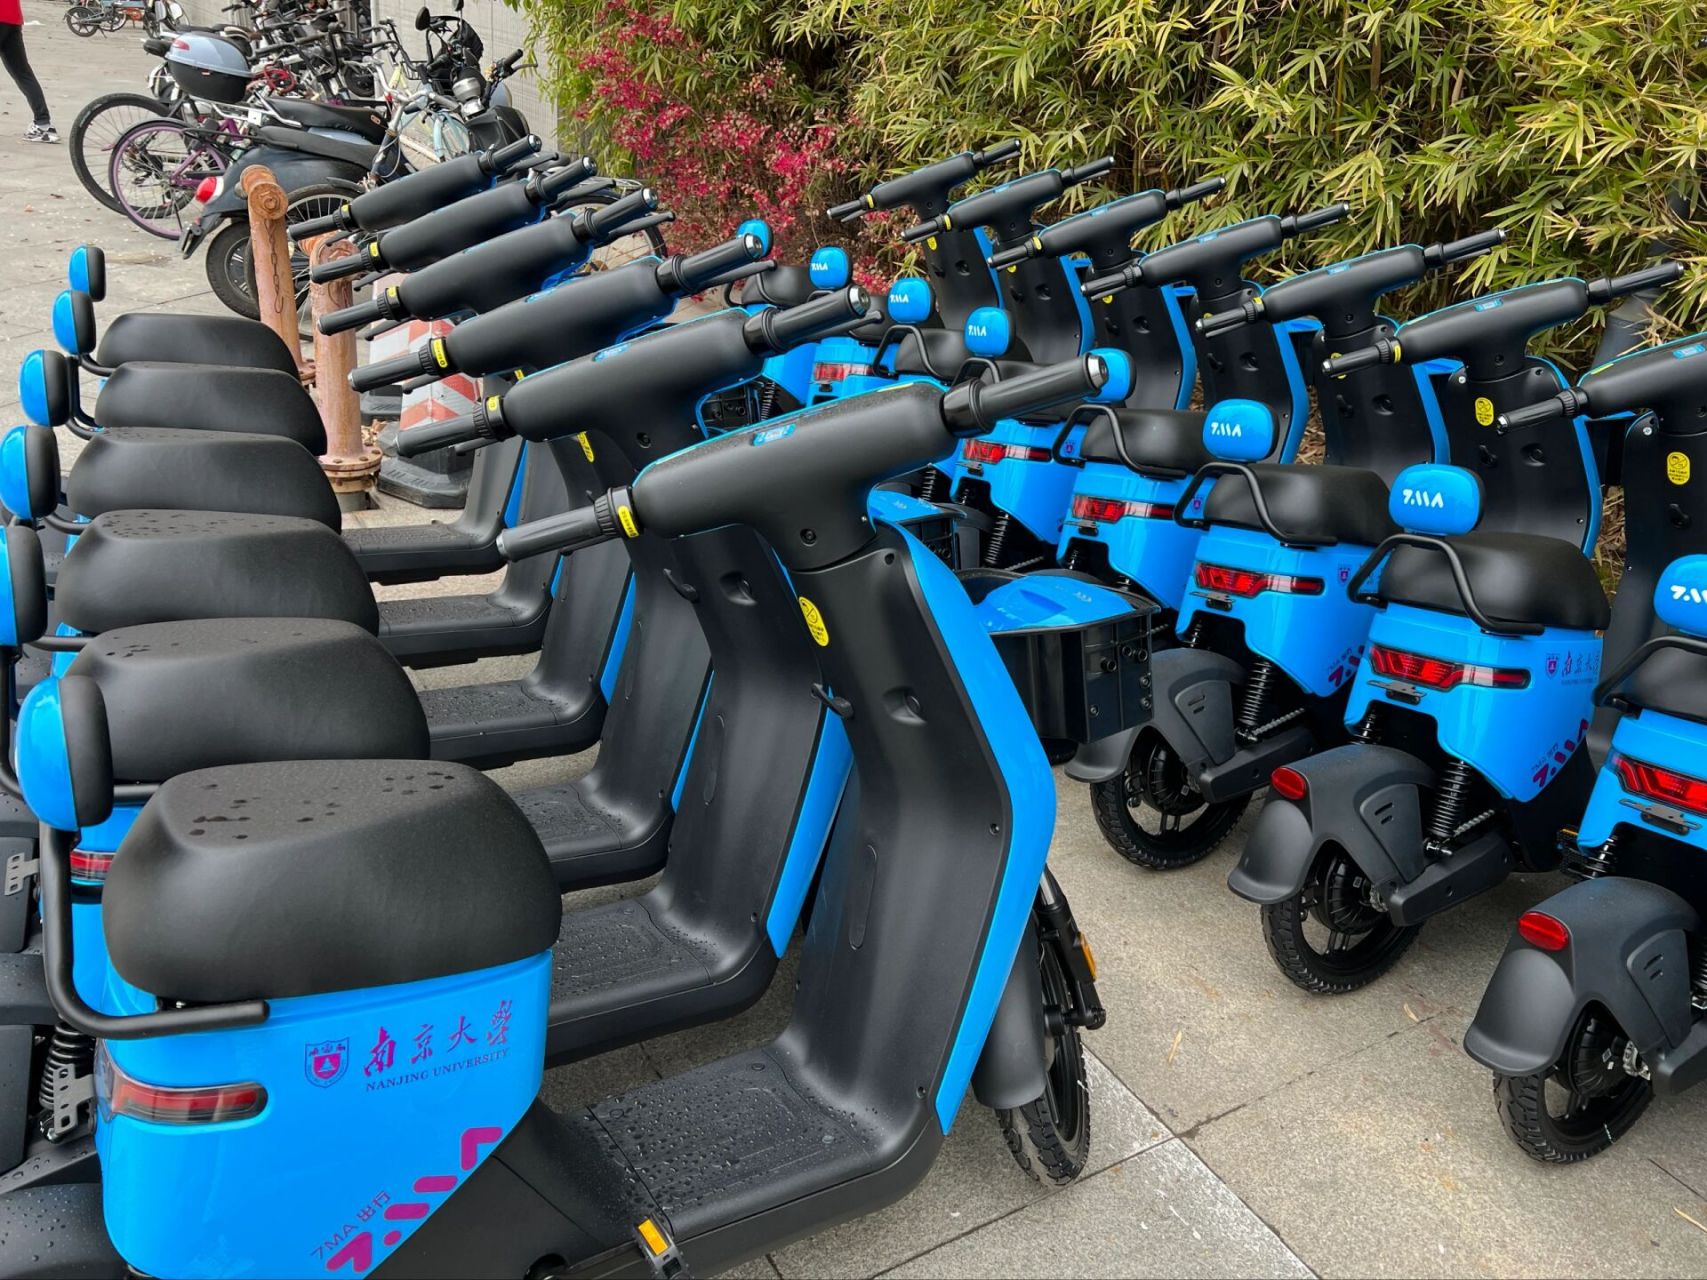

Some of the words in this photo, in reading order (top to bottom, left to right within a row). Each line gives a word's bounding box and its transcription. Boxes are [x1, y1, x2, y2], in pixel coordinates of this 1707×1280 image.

[366, 1071, 429, 1092] NANJING
[433, 1048, 510, 1077] UNIVERSITY
[310, 1223, 359, 1260] 7MA
[356, 1190, 391, 1223] 出行
